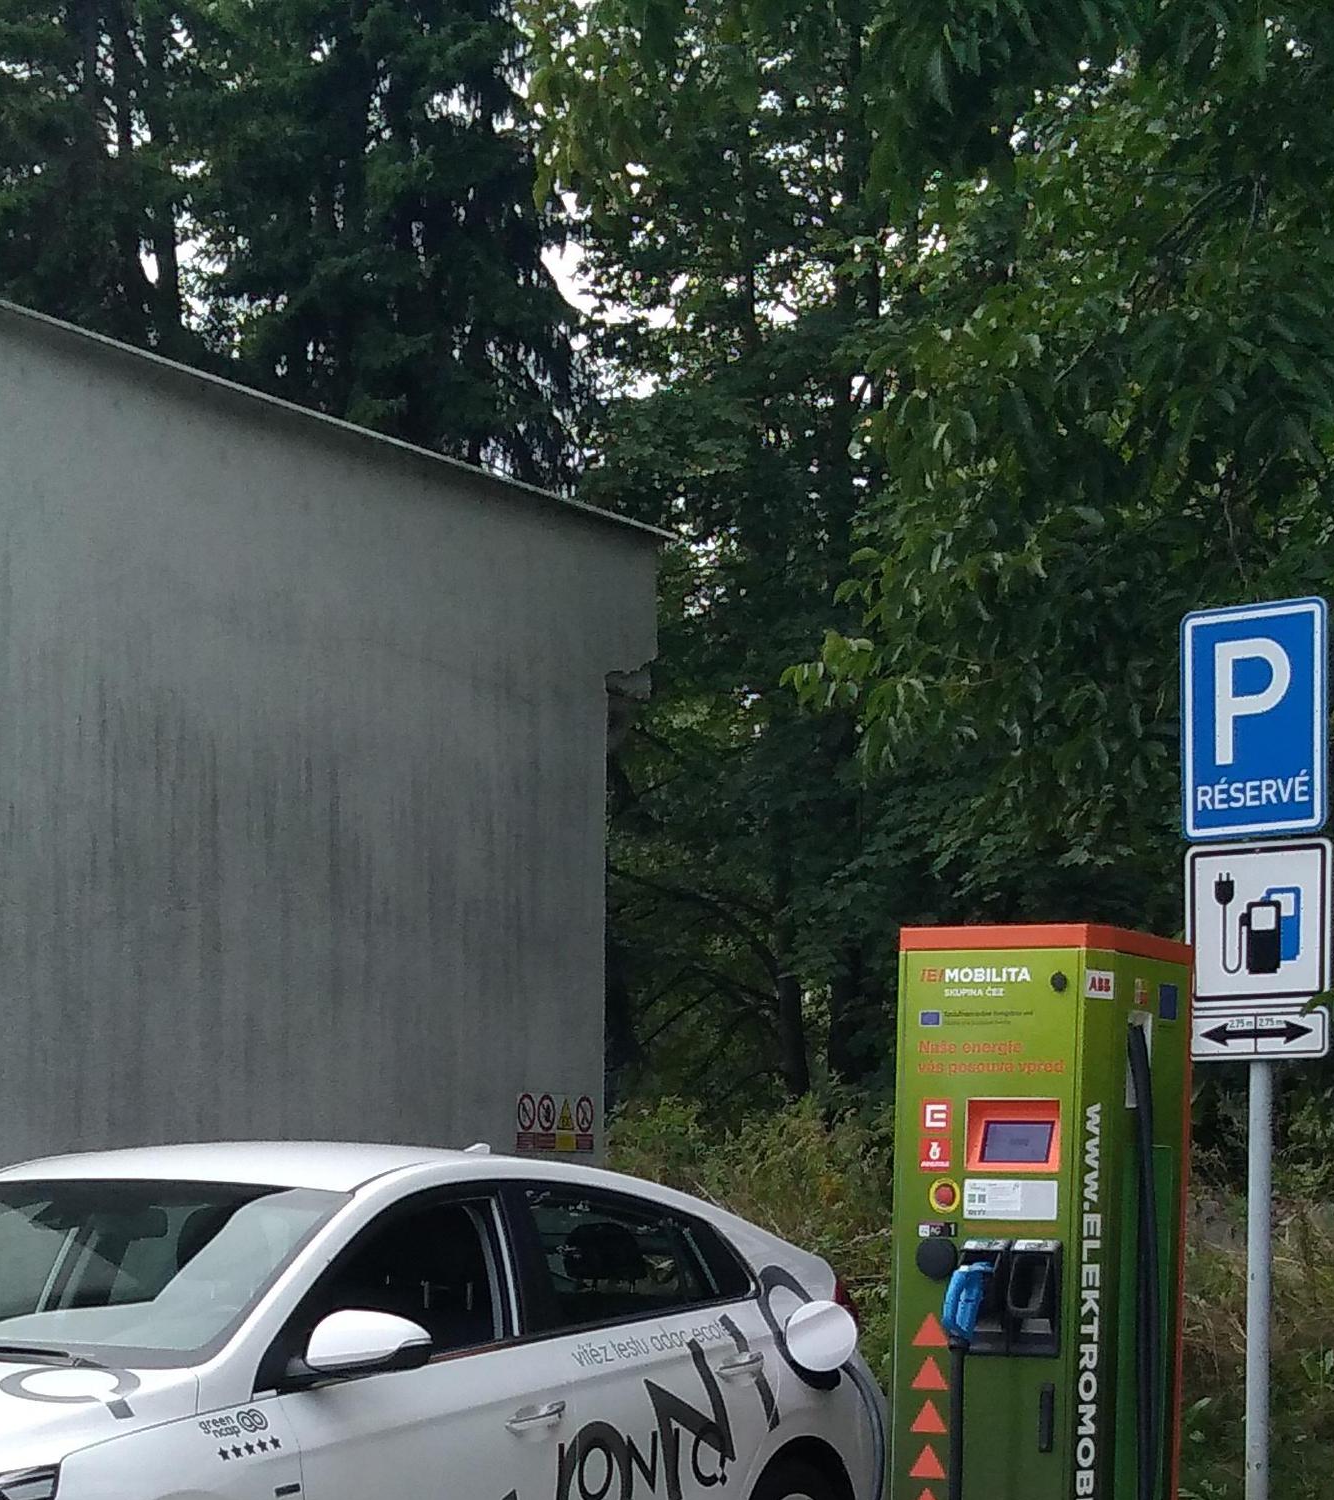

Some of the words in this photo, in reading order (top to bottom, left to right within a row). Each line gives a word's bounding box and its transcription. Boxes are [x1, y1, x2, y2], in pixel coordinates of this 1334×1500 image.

[1214, 637, 1291, 766] P
[1196, 769, 1310, 811] RÉSERVÉ
[1089, 976, 1110, 992] ABB
[199, 1415, 235, 1435] green
[211, 1425, 241, 1438] ncap
